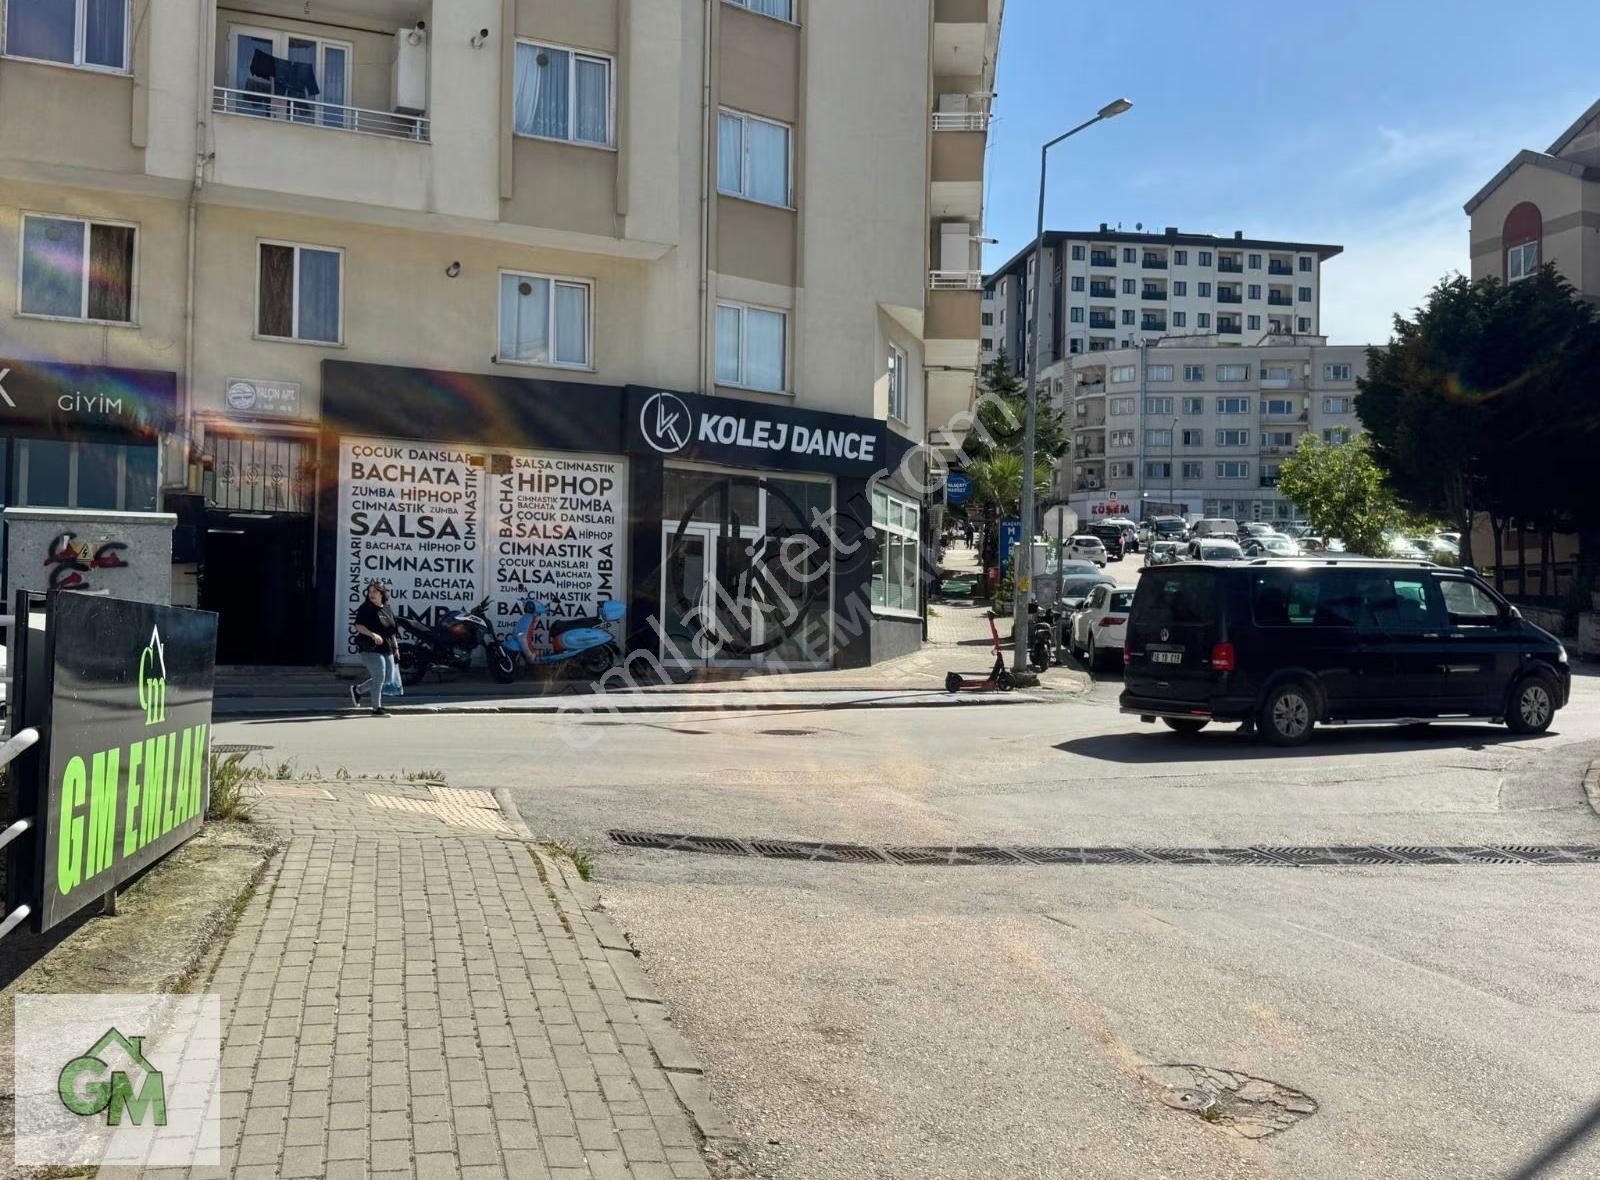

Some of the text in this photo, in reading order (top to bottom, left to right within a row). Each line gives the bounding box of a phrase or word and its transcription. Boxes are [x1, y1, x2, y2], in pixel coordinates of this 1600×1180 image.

[57, 391, 122, 415] GİYİM
[698, 413, 876, 461] KOLEJ DANCE
[351, 445, 472, 464] ÇOCUK DANSLAR
[351, 462, 460, 486] BACHATA
[515, 458, 615, 473] SALSA CIMNASTIK
[518, 469, 614, 497] HİPHOP
[351, 485, 463, 504] ZUMBA HİPHOP
[430, 506, 459, 515] ZUMBA
[464, 467, 478, 551] CIMNASTIK
[517, 502, 555, 511] BACHATA
[559, 497, 613, 513] ZUMBA
[350, 511, 461, 541] SALSA
[516, 510, 615, 525] ÇOCUK DANSLARI
[515, 523, 613, 540] SALSA HİPHOP
[365, 540, 461, 553] BACHATA HİPHOP
[499, 541, 593, 559] CIMNASTIK
[349, 536, 362, 602] DANSLARI
[364, 555, 475, 574] CIMNASTIK
[498, 558, 589, 570] ÇOCUK DANSLARI
[496, 568, 556, 584] SALSA
[555, 570, 592, 579] BACHATA
[414, 577, 475, 590] BACHATA
[556, 580, 592, 589] HİPHOP
[412, 589, 474, 601] DANSLARI
[57, 724, 207, 895] GM EMLAK
